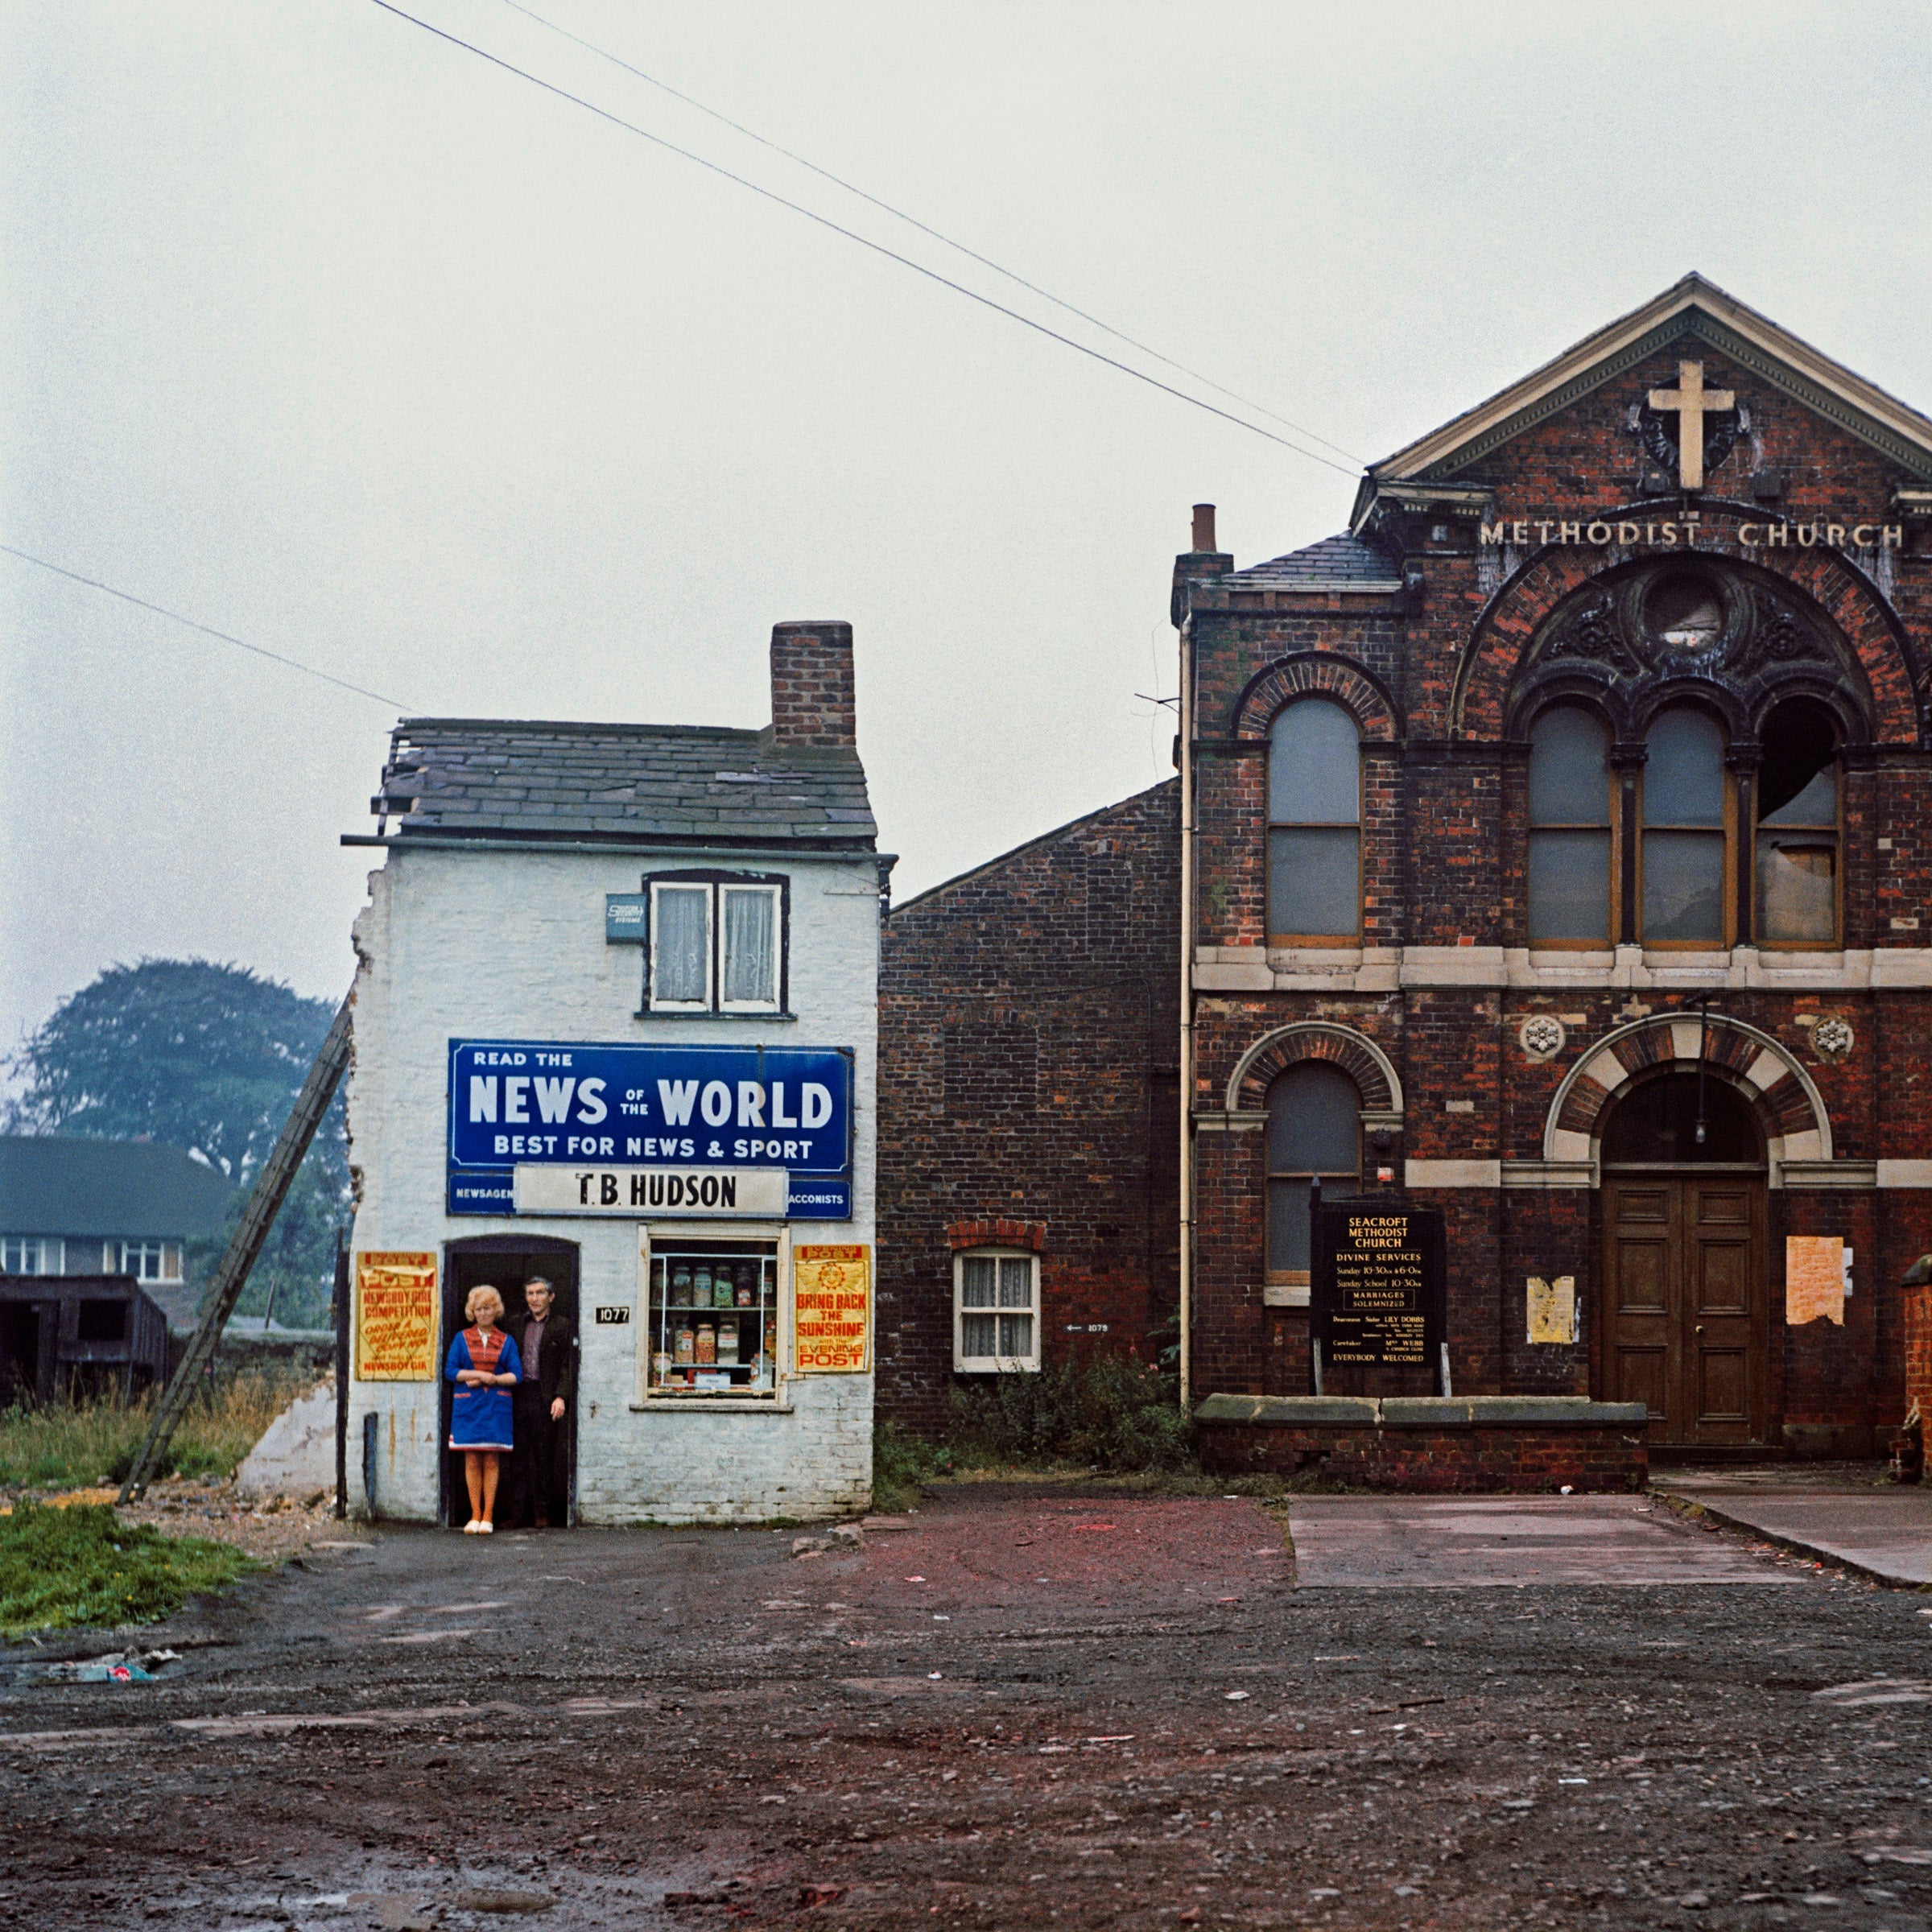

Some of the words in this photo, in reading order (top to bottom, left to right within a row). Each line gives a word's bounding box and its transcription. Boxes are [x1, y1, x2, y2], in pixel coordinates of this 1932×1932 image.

[1480, 521, 1701, 547] METHODIST
[1738, 522, 1902, 547] CHURCH
[474, 1052, 526, 1066] READ
[536, 1053, 572, 1067] THE
[625, 1089, 644, 1100] OF
[469, 1075, 608, 1125] NEWS
[657, 1080, 832, 1129] WORLD
[620, 1104, 648, 1116] THE
[494, 1135, 558, 1154] BEST
[568, 1136, 613, 1156] FOR
[627, 1138, 695, 1157] NEWS
[708, 1141, 724, 1158] &
[733, 1140, 812, 1159] SPORT
[630, 1174, 736, 1208] HUDSON
[788, 1195, 844, 1204] ACCONISTS
[1349, 1217, 1408, 1227] SEACROFT
[1349, 1228, 1408, 1237] METHODIST
[1355, 1238, 1402, 1248] CHURCH
[1336, 1253, 1370, 1261] DIVINE
[1376, 1253, 1421, 1261] SERVICES
[1336, 1266, 1360, 1275] Sunday
[1336, 1279, 1361, 1288] Sunday
[1364, 1279, 1387, 1287] School
[796, 1294, 834, 1309] BRING
[836, 1294, 865, 1309] BACK
[365, 1306, 431, 1319] COMPETITION
[601, 1308, 629, 1321] 1077
[820, 1311, 843, 1321] THE
[404, 1319, 411, 1329] A
[1088, 1324, 1108, 1332] 1079
[798, 1323, 864, 1336] SUNSHINE
[799, 1344, 863, 1353] EVENING
[799, 1353, 863, 1366] POST
[1333, 1353, 1376, 1361] EVERYBODY
[1382, 1354, 1424, 1362] WELCOMED
[364, 1361, 409, 1371] NEWSBOY
